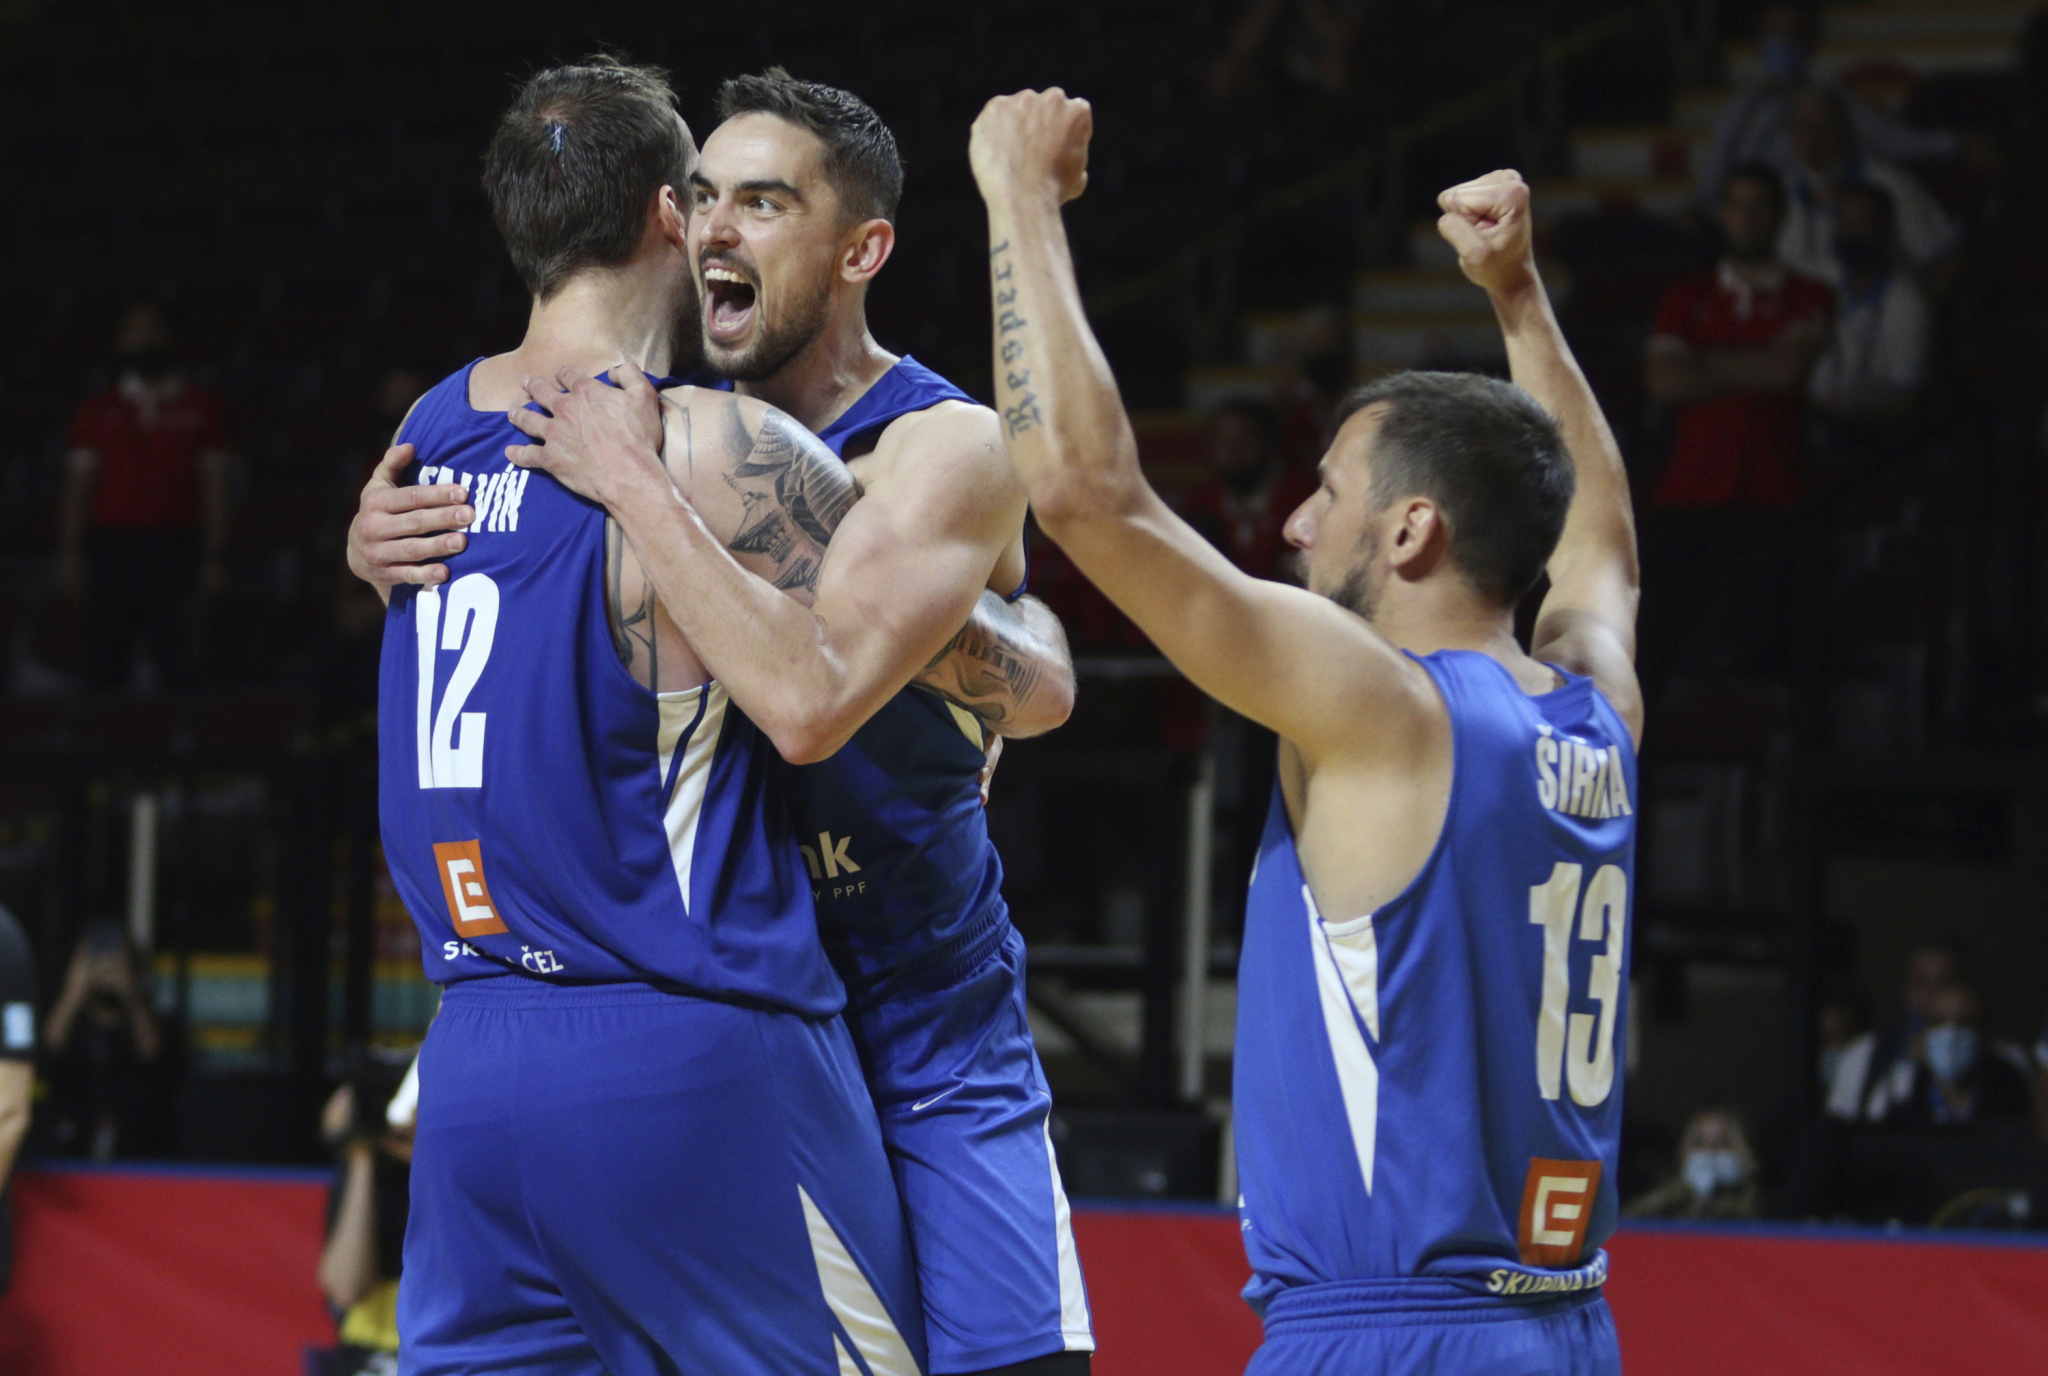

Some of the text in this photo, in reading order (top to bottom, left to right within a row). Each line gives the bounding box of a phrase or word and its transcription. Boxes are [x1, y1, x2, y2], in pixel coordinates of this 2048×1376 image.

[416, 573, 500, 789] 12
[833, 881, 866, 899] PPF
[1529, 861, 1627, 1107] 13
